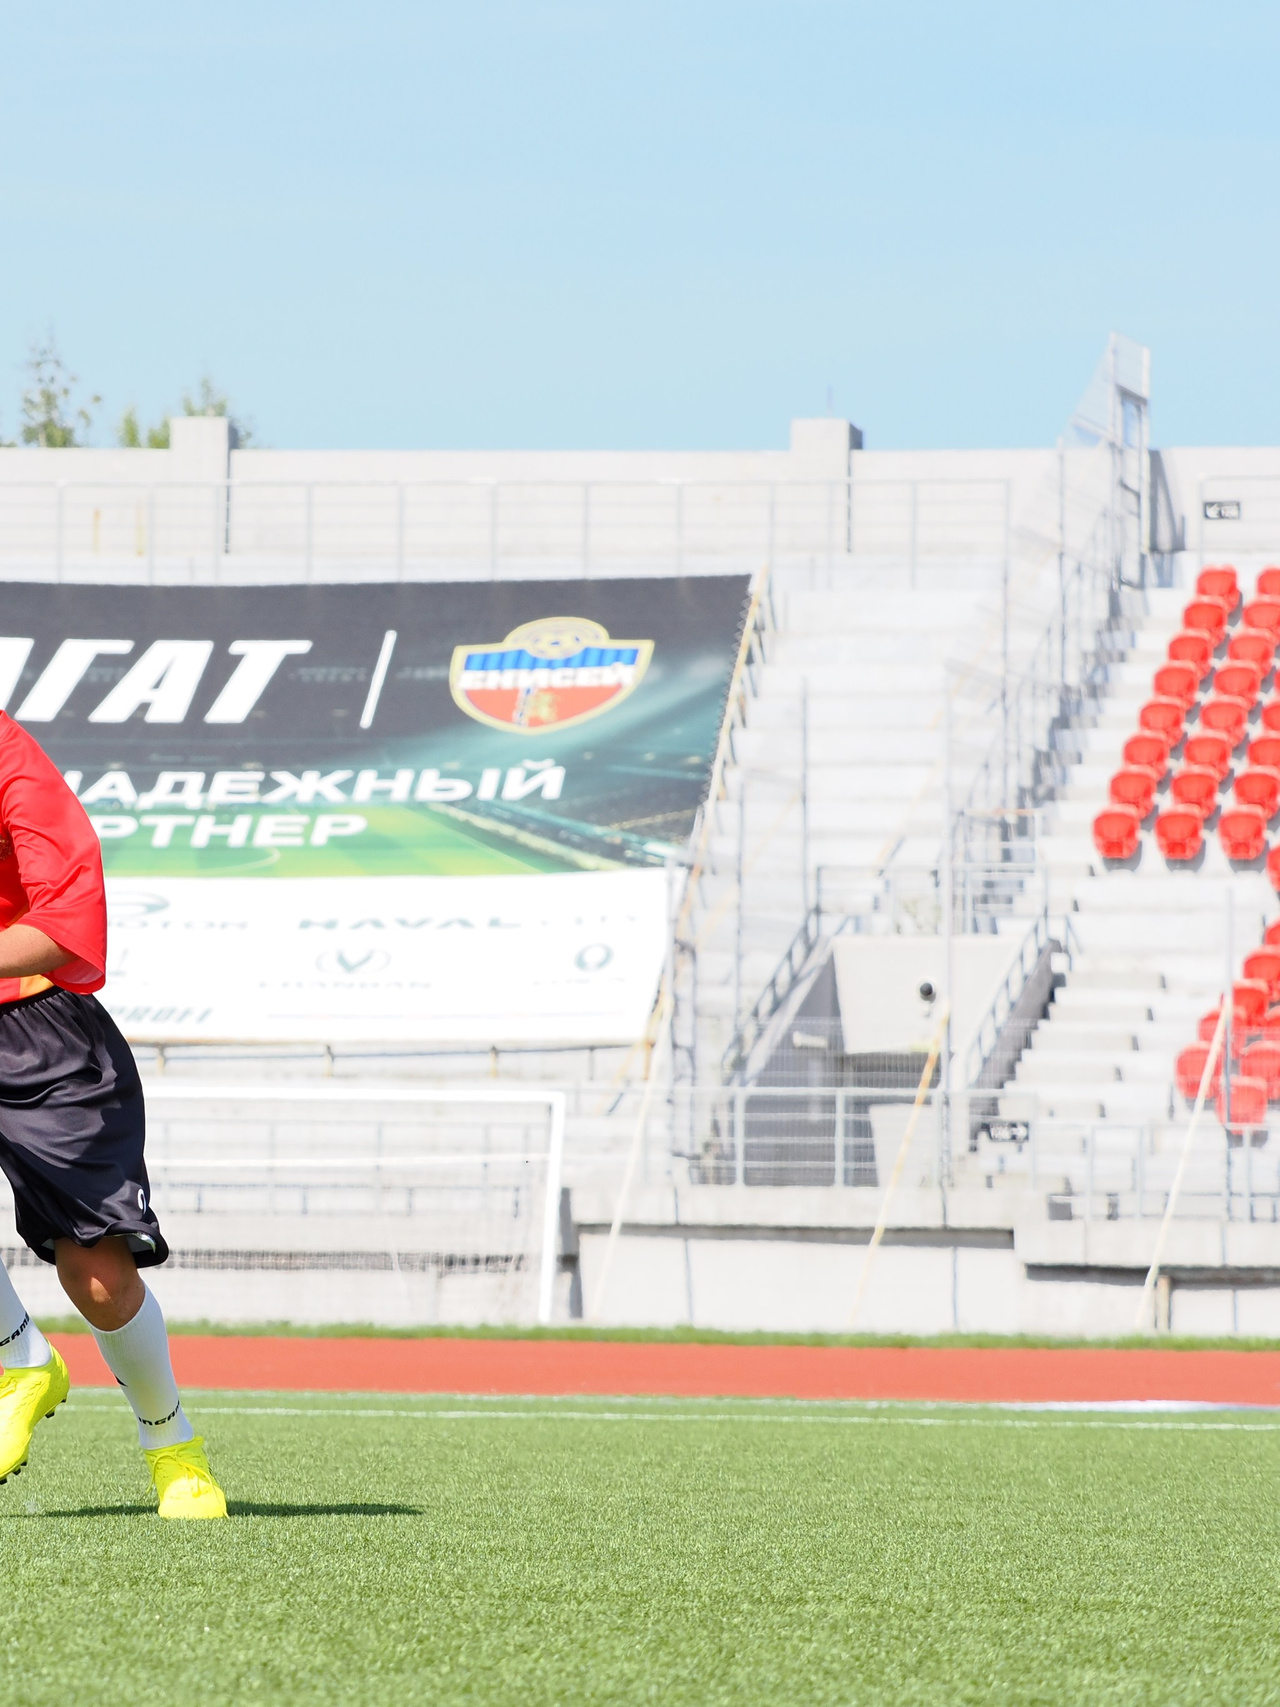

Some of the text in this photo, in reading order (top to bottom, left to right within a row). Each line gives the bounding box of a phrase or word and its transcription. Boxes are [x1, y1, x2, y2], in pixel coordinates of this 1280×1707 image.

[458, 661, 637, 691] ЕНИСЕЙ
[89, 814, 368, 848] РТНЕР
[297, 916, 522, 931] HAVAL
